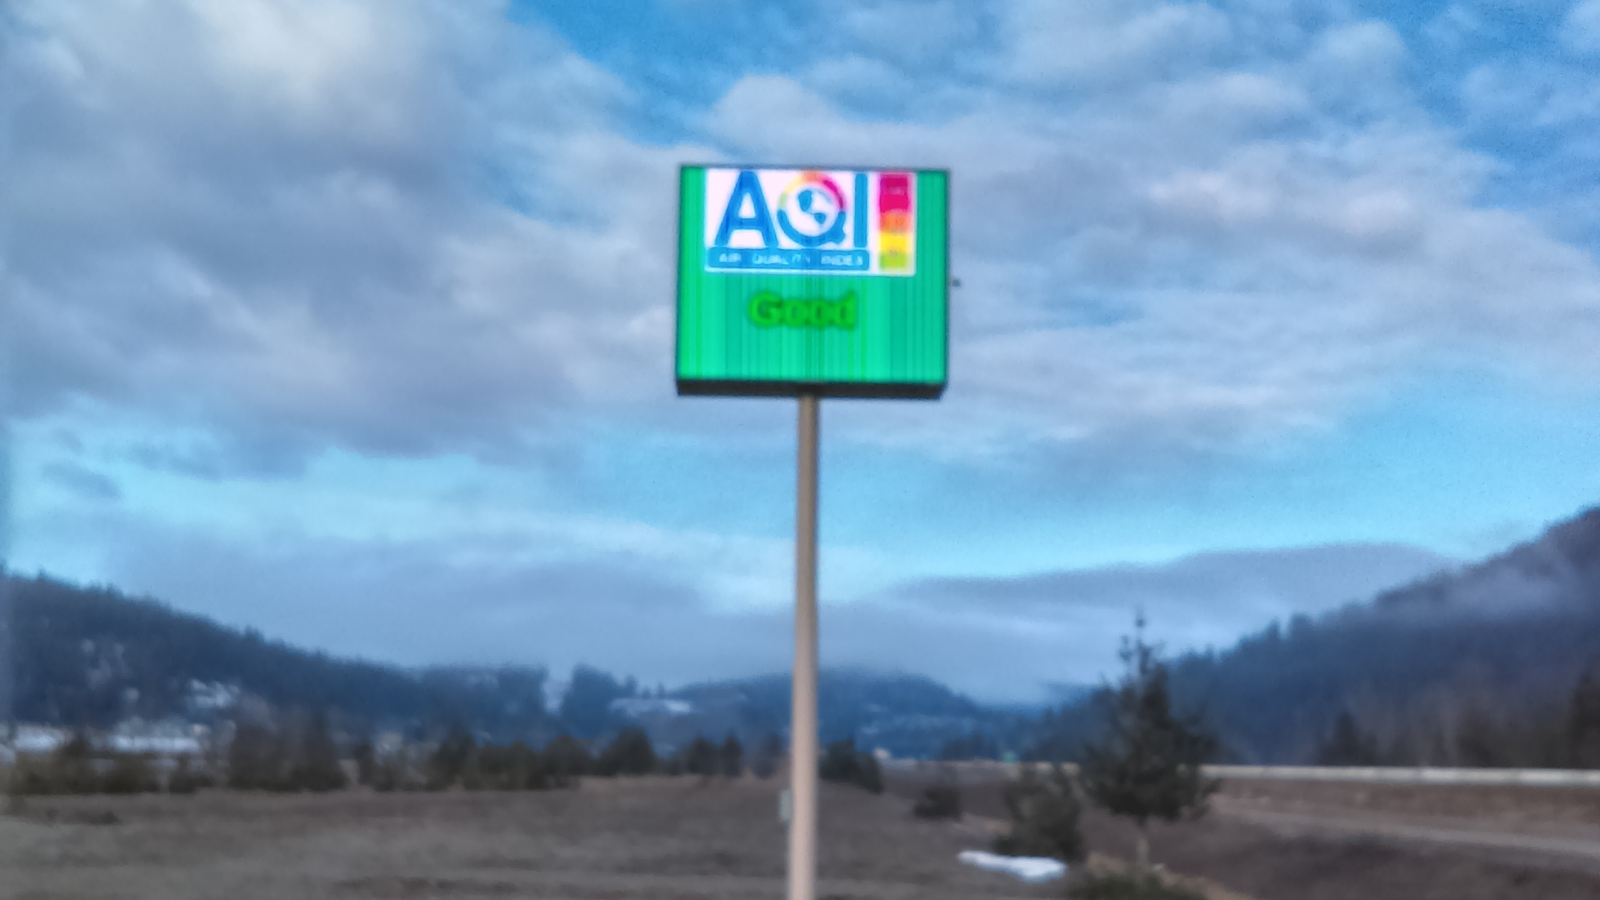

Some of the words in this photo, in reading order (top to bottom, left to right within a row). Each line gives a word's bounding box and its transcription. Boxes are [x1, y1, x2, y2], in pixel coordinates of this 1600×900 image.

[714, 170, 867, 248] AQI
[719, 253, 742, 263] AIR
[749, 290, 857, 329] Good
